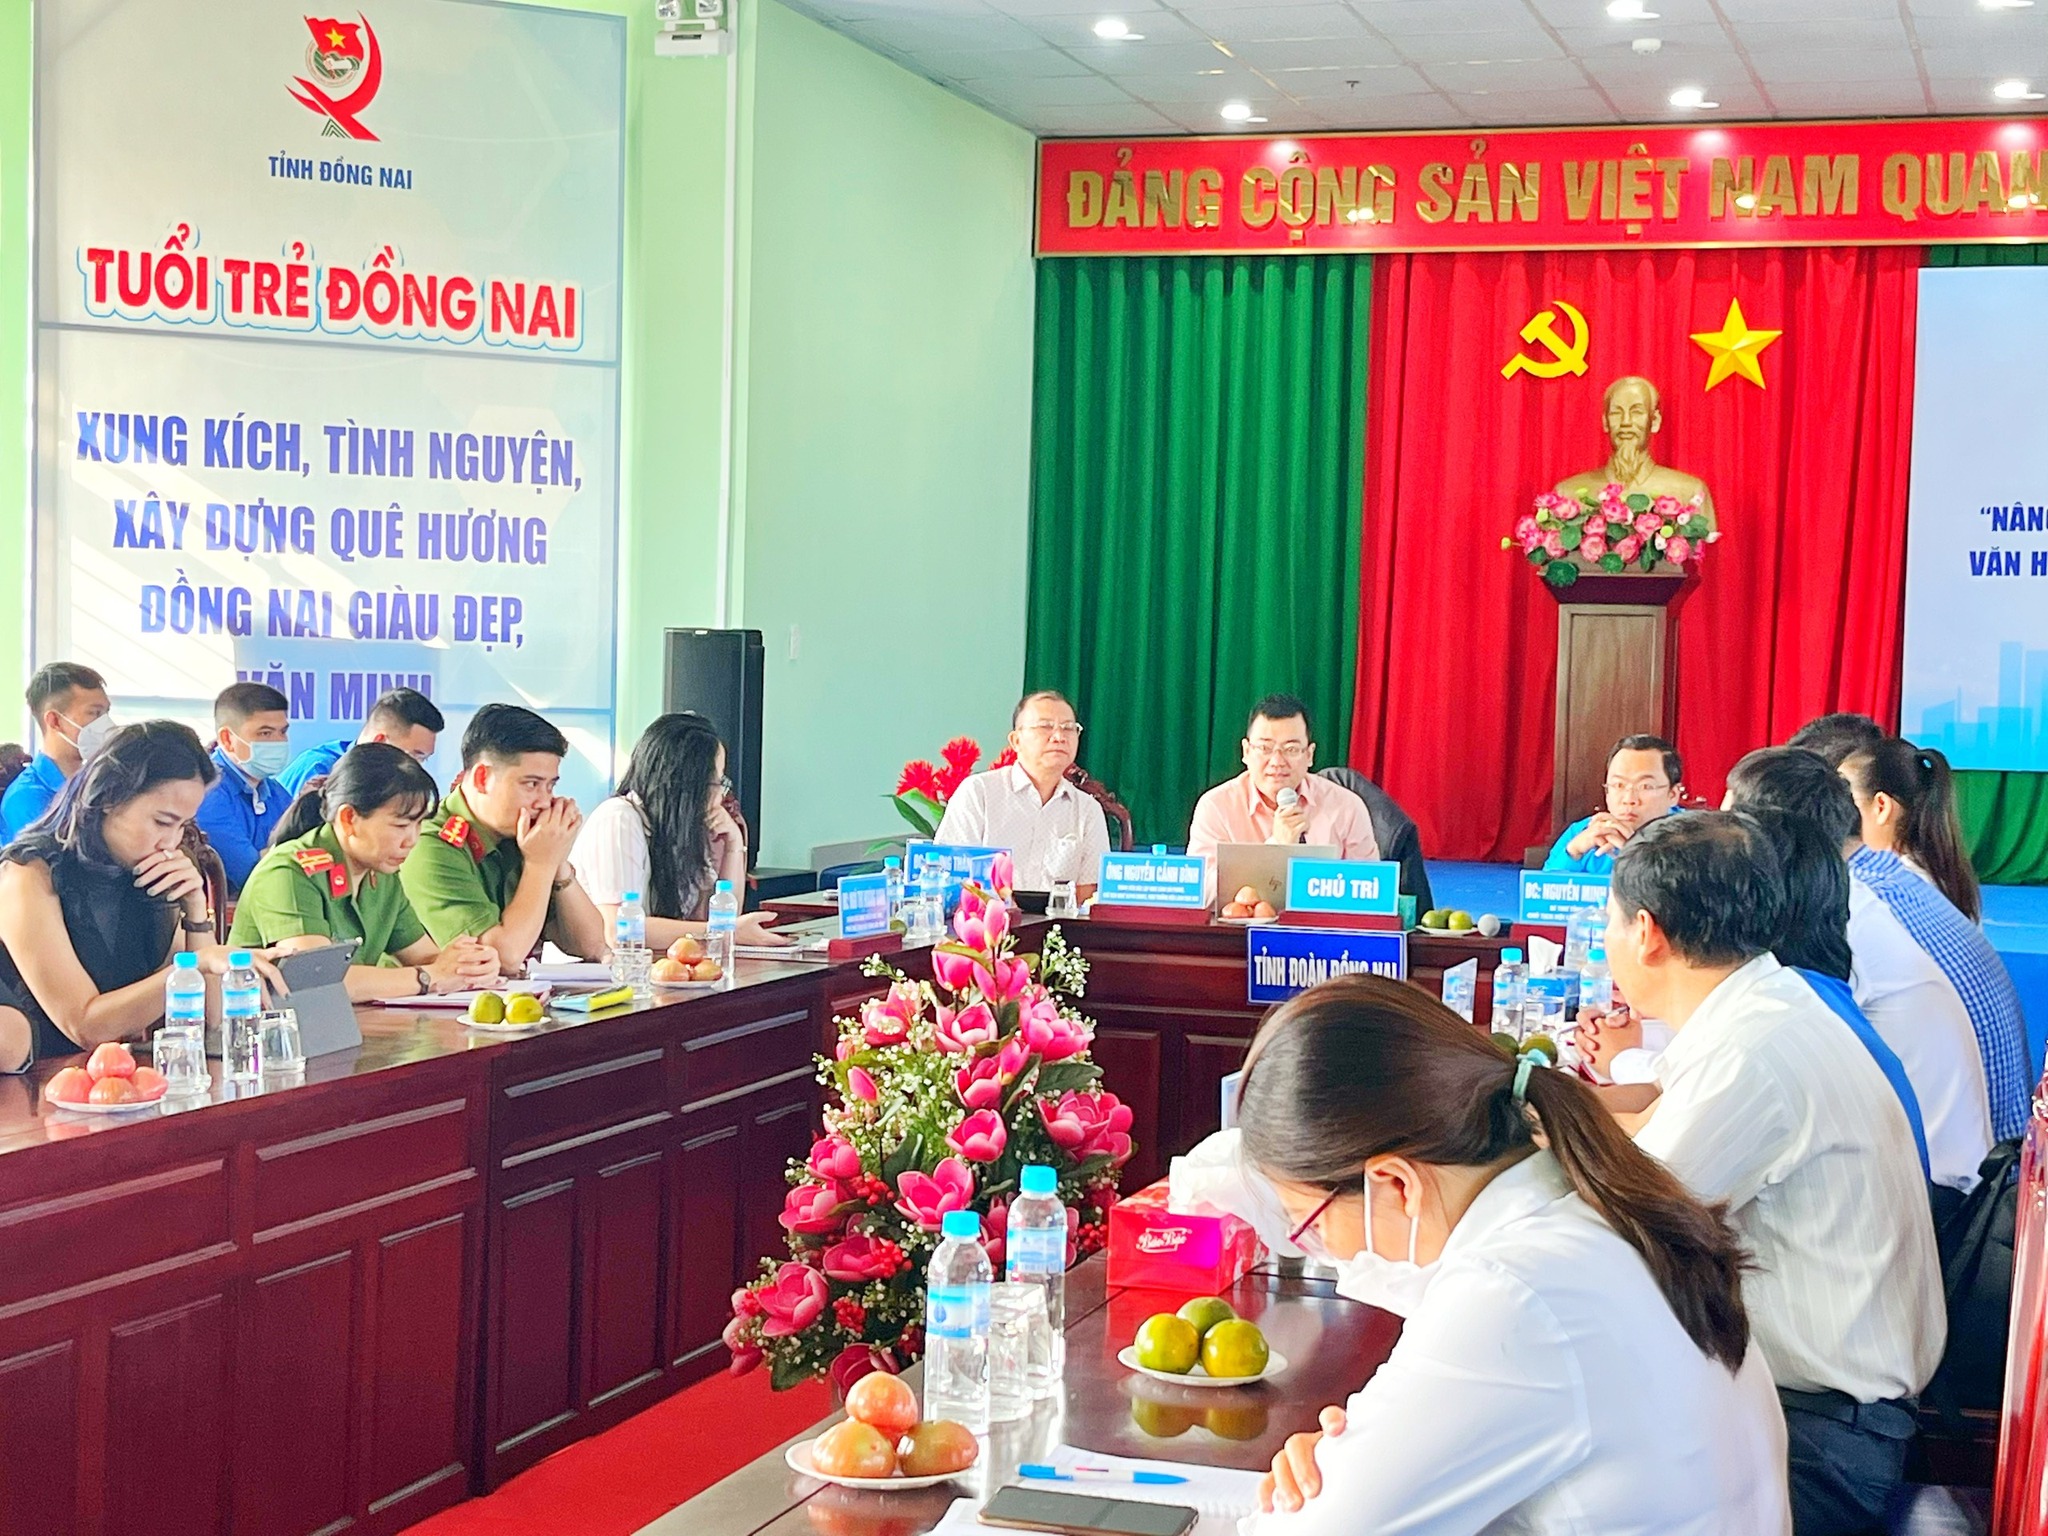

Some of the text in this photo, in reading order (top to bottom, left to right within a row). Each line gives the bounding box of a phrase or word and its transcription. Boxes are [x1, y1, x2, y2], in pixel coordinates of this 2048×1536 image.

[269, 150, 412, 190] TỈNH ĐỒNG NAI
[1067, 147, 1222, 229] ĐẢNG
[1241, 150, 1396, 240] CỘNG
[1416, 138, 1541, 223] SẢN
[1563, 142, 1690, 235] VIỆT
[1711, 154, 1860, 217] NAM
[86, 221, 576, 338] TUỔI TRẺ ĐỒNG NAI
[76, 412, 582, 494] XUNG KÍCH, TÌNH NGUYỆN,
[112, 491, 547, 564] XÂY DỰNG QUÊ HƯƠNG
[1980, 501, 2048, 532] “NÂN
[1969, 546, 2021, 576] VĂN
[139, 568, 525, 652] ĐỒNG NAI GIÀU ĐẸP,
[236, 661, 315, 720] ĂN
[1307, 872, 1379, 900] CHỦ TRÌ
[1254, 946, 1286, 986] TỈNH
